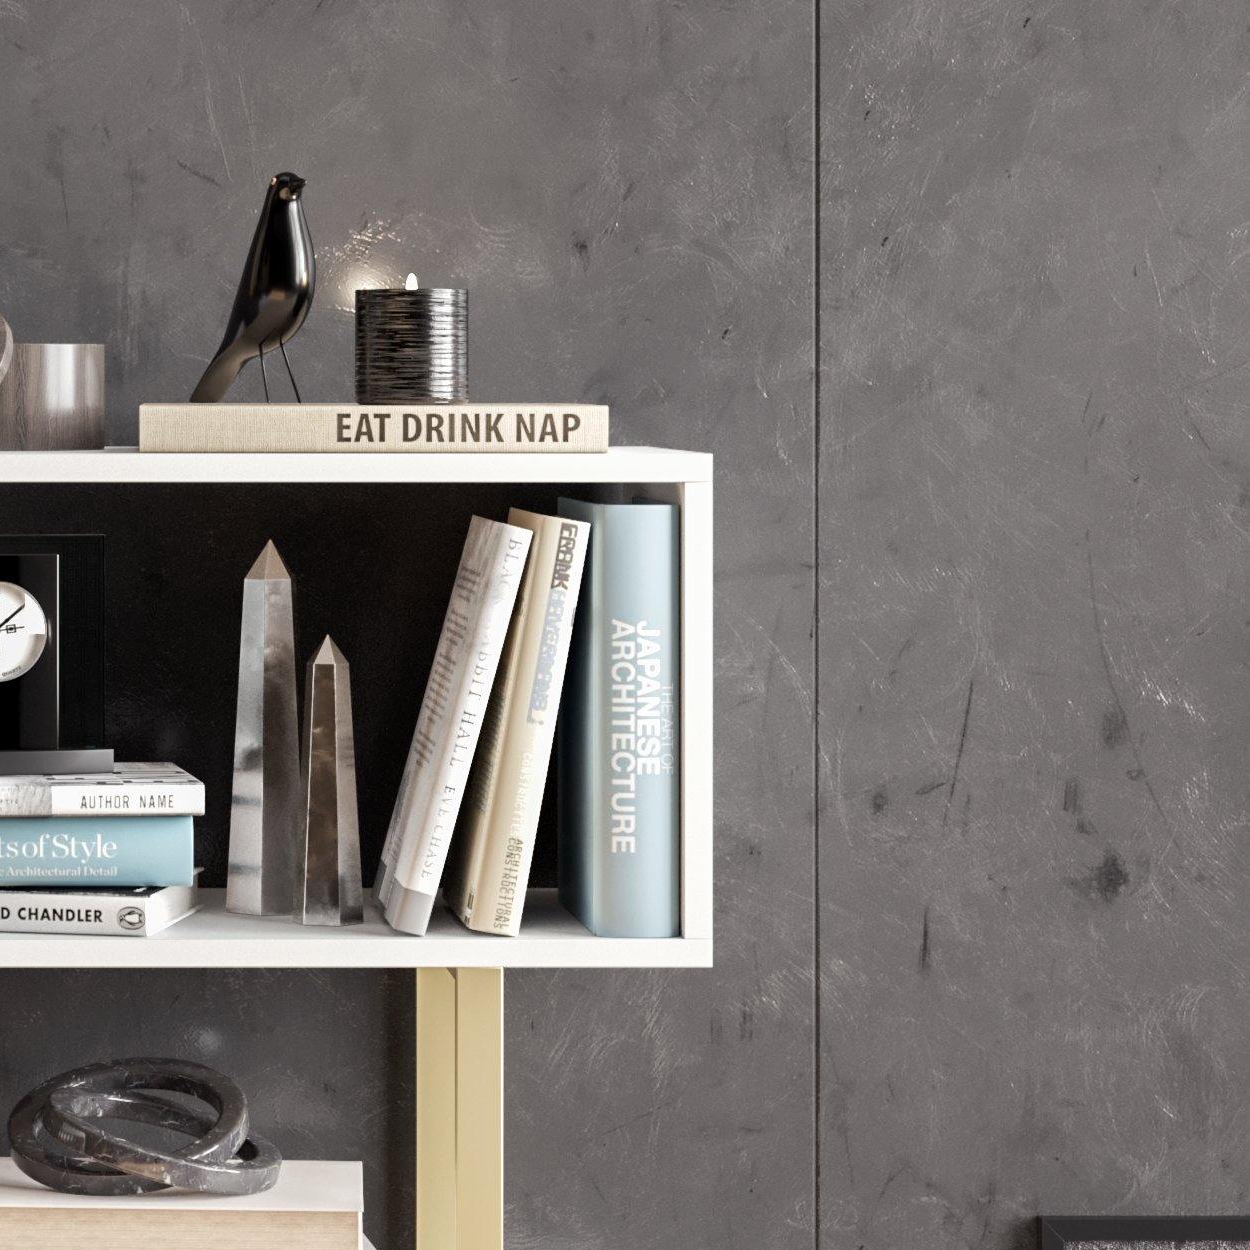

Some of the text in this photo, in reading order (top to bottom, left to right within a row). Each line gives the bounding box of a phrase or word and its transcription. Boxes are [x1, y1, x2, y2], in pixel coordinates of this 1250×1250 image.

[336, 413, 581, 443] EAT DRINK NAP
[551, 522, 578, 590] FRANK
[637, 620, 661, 776] JAPANESE
[450, 711, 477, 767] HALL
[611, 619, 636, 853] ARCHITECTURE
[661, 684, 674, 775] THE ART OF
[80, 795, 130, 809] AUTHOR
[139, 795, 174, 808] NAME
[439, 785, 456, 816] EVE
[7, 866, 81, 877] Architectural
[83, 866, 118, 877] Detail
[21, 833, 50, 859] of
[52, 833, 118, 863] Style
[422, 826, 443, 878] CHASE
[503, 838, 524, 930] ARCHITECTURAL
[18, 907, 103, 923] CHANDLER
